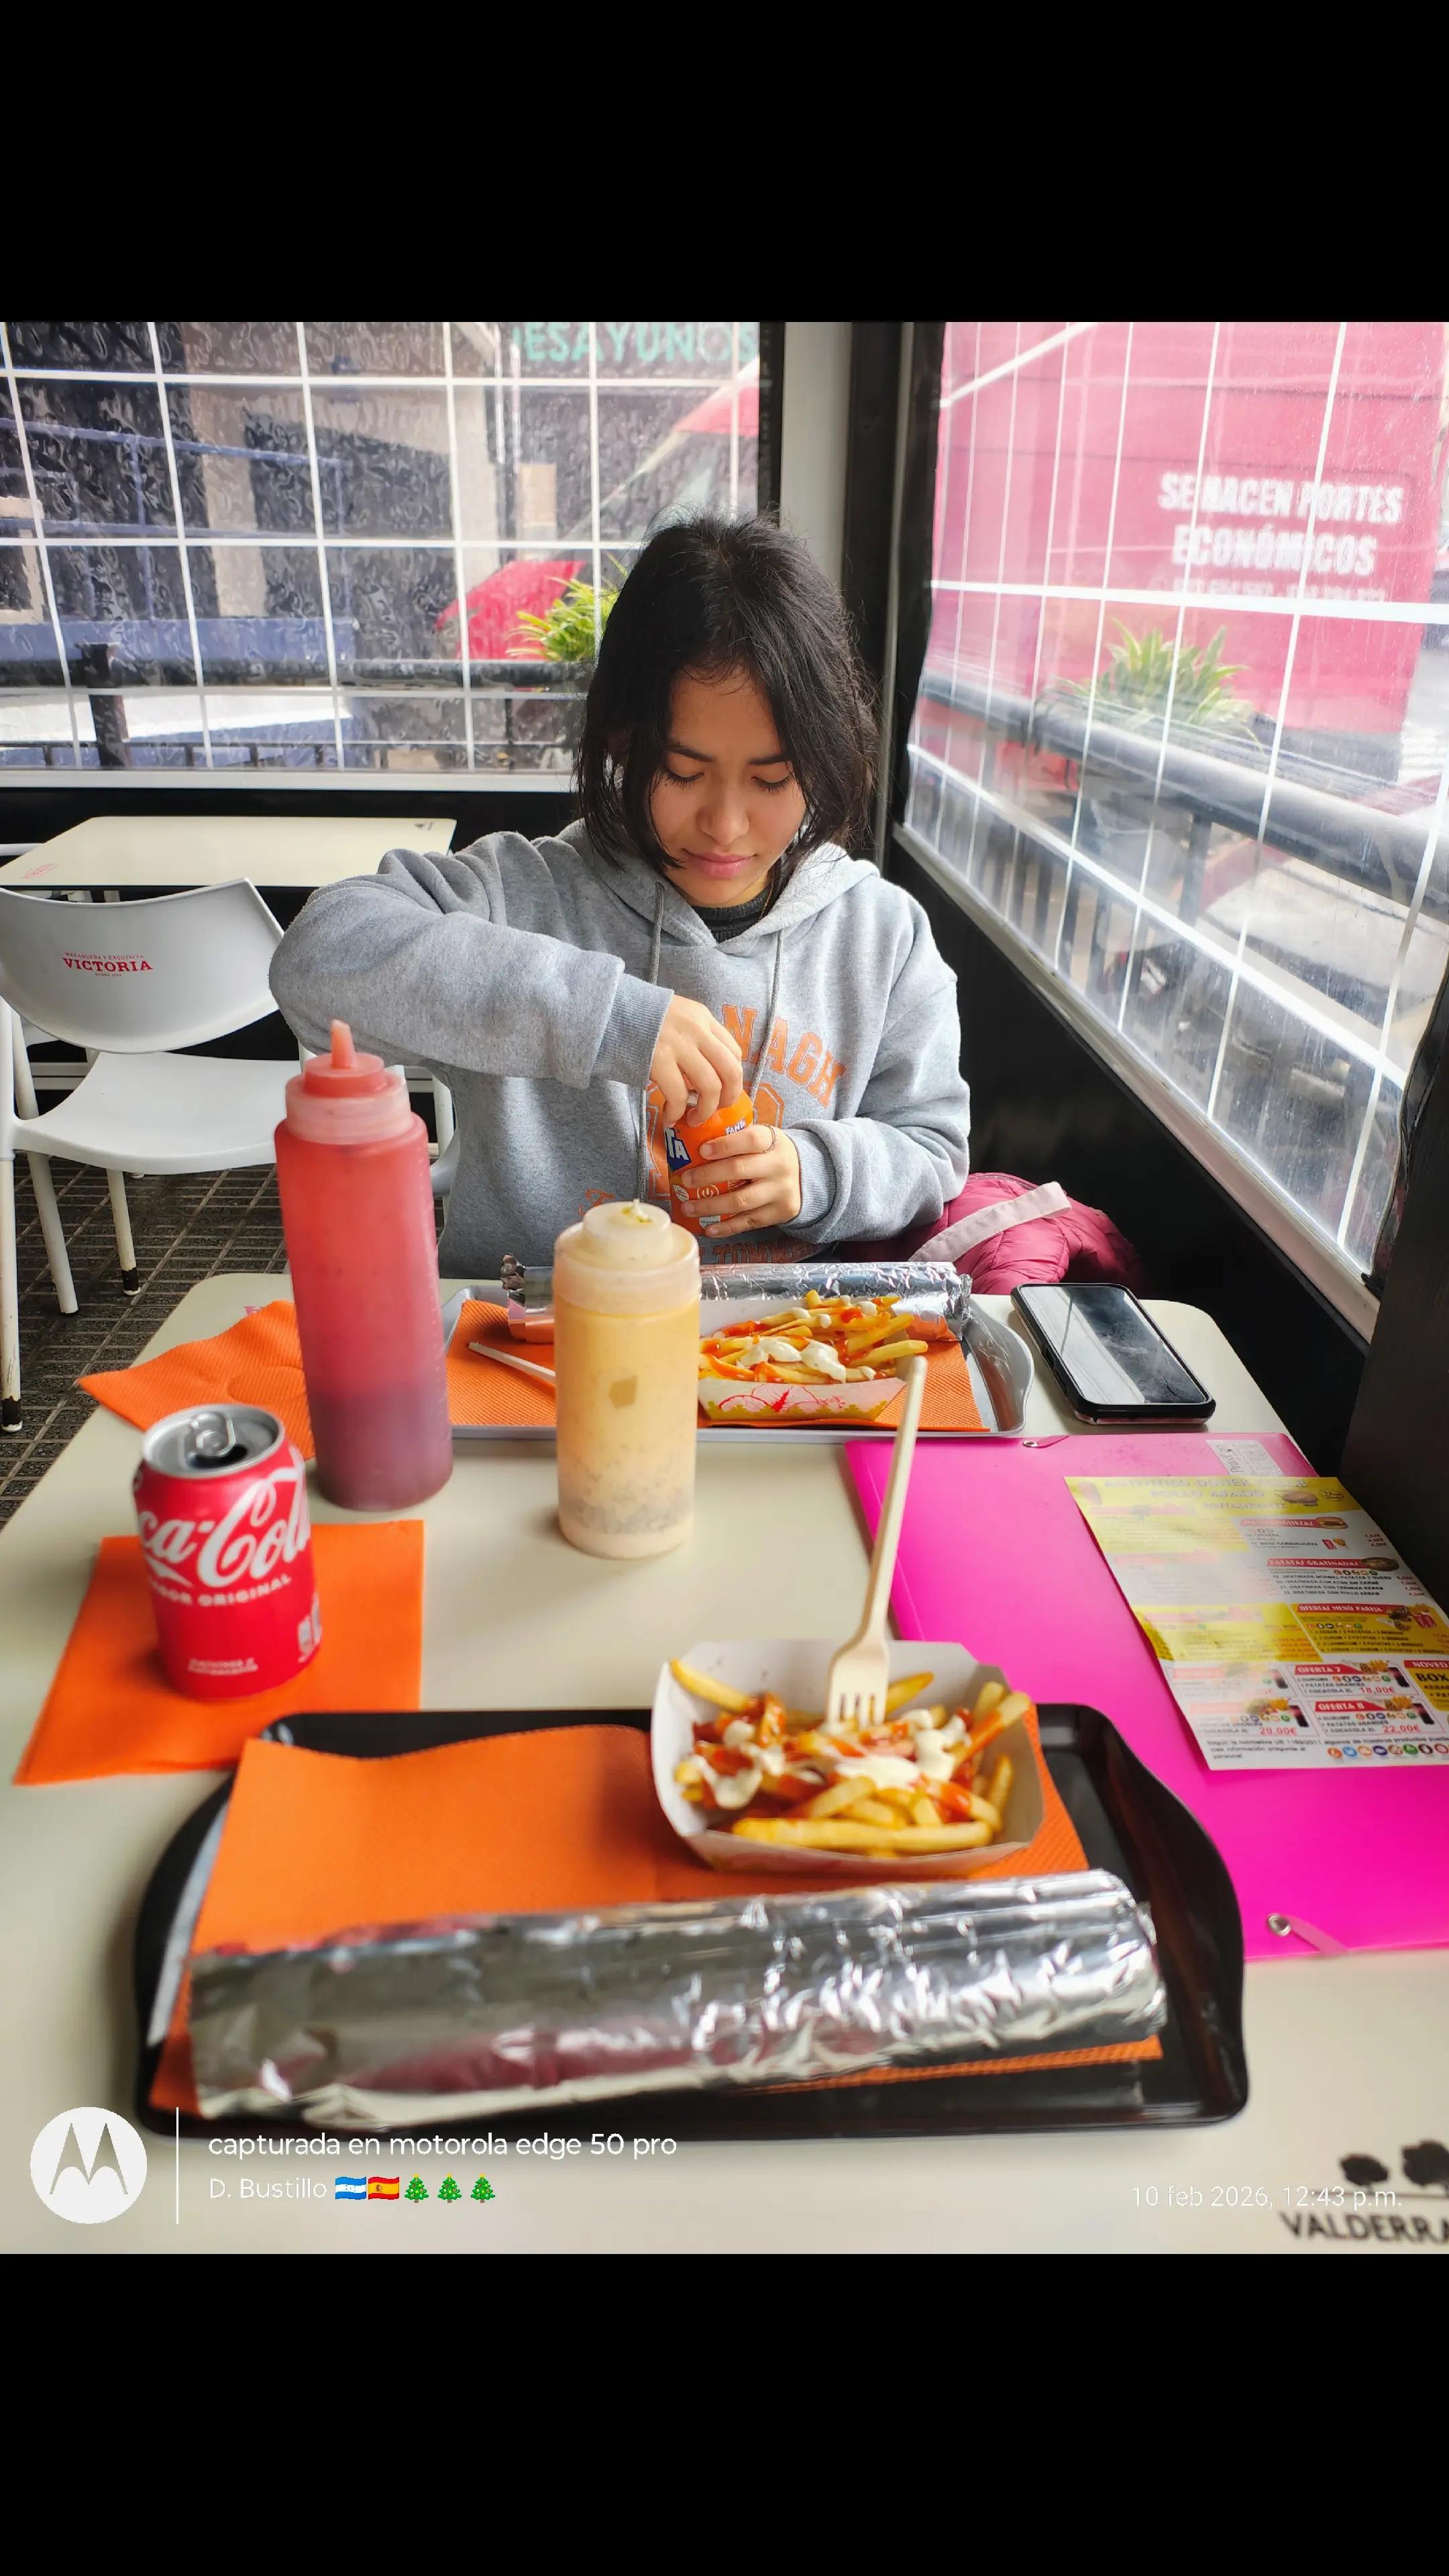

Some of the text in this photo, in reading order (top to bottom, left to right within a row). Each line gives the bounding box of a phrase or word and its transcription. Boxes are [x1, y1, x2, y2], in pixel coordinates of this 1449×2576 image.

[514, 322, 759, 363] ESAYUNOS
[1158, 472, 1404, 524] SE HACEN PORTES
[1173, 523, 1378, 576] ECONÓMICOS
[62, 957, 154, 972] VICTORIA
[722, 1004, 846, 1109] NAGH
[197, 1574, 292, 1607] ORIGINAL
[1415, 1673, 1449, 1682] BOX
[1259, 1727, 1297, 1735] 20,00€
[1382, 1725, 1421, 1733] 22,00€
